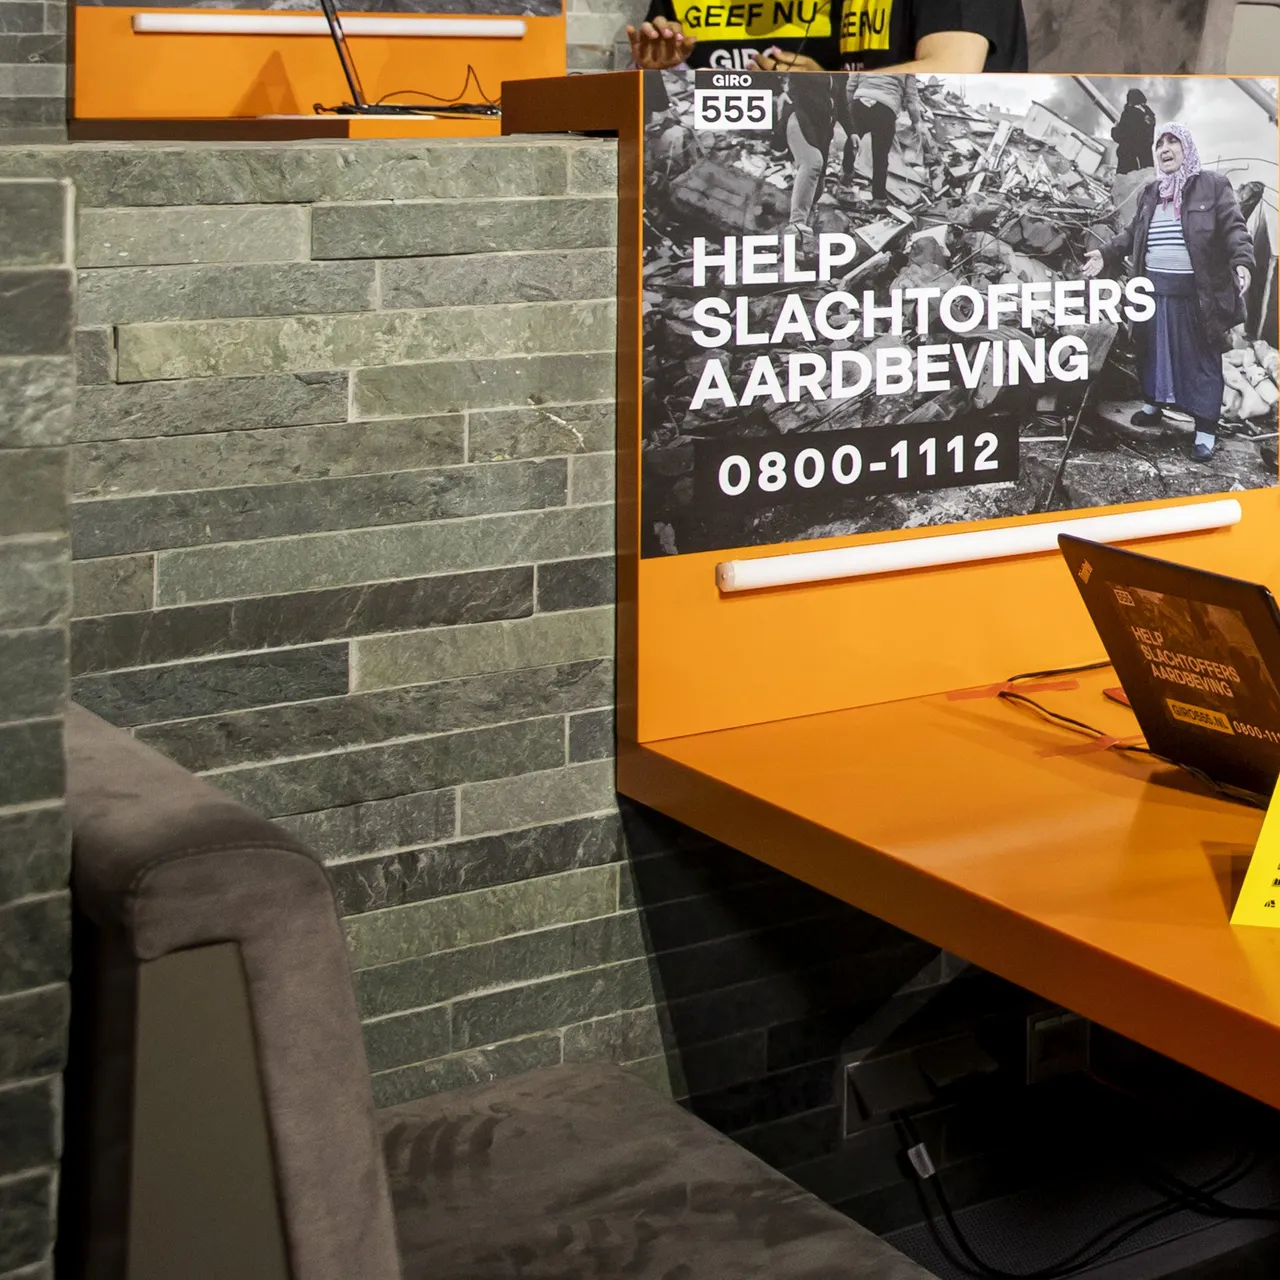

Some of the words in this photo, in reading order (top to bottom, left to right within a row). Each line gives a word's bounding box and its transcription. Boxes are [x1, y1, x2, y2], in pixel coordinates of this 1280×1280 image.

[684, 3, 764, 29] GEEF
[772, 0, 819, 24] NU
[712, 74, 752, 87] GIRO
[701, 95, 767, 123] 555
[692, 232, 858, 288] HELP
[690, 276, 1158, 349] SLACHTOFFERS
[689, 335, 1090, 411] AARDBEVING
[717, 431, 1001, 498] 0800-1112
[1130, 625, 1164, 647] HELP
[1140, 645, 1241, 684] SLACHTOFFERS
[1151, 662, 1235, 698] AARDBEVING
[1170, 703, 1231, 730] GIRO555.NL
